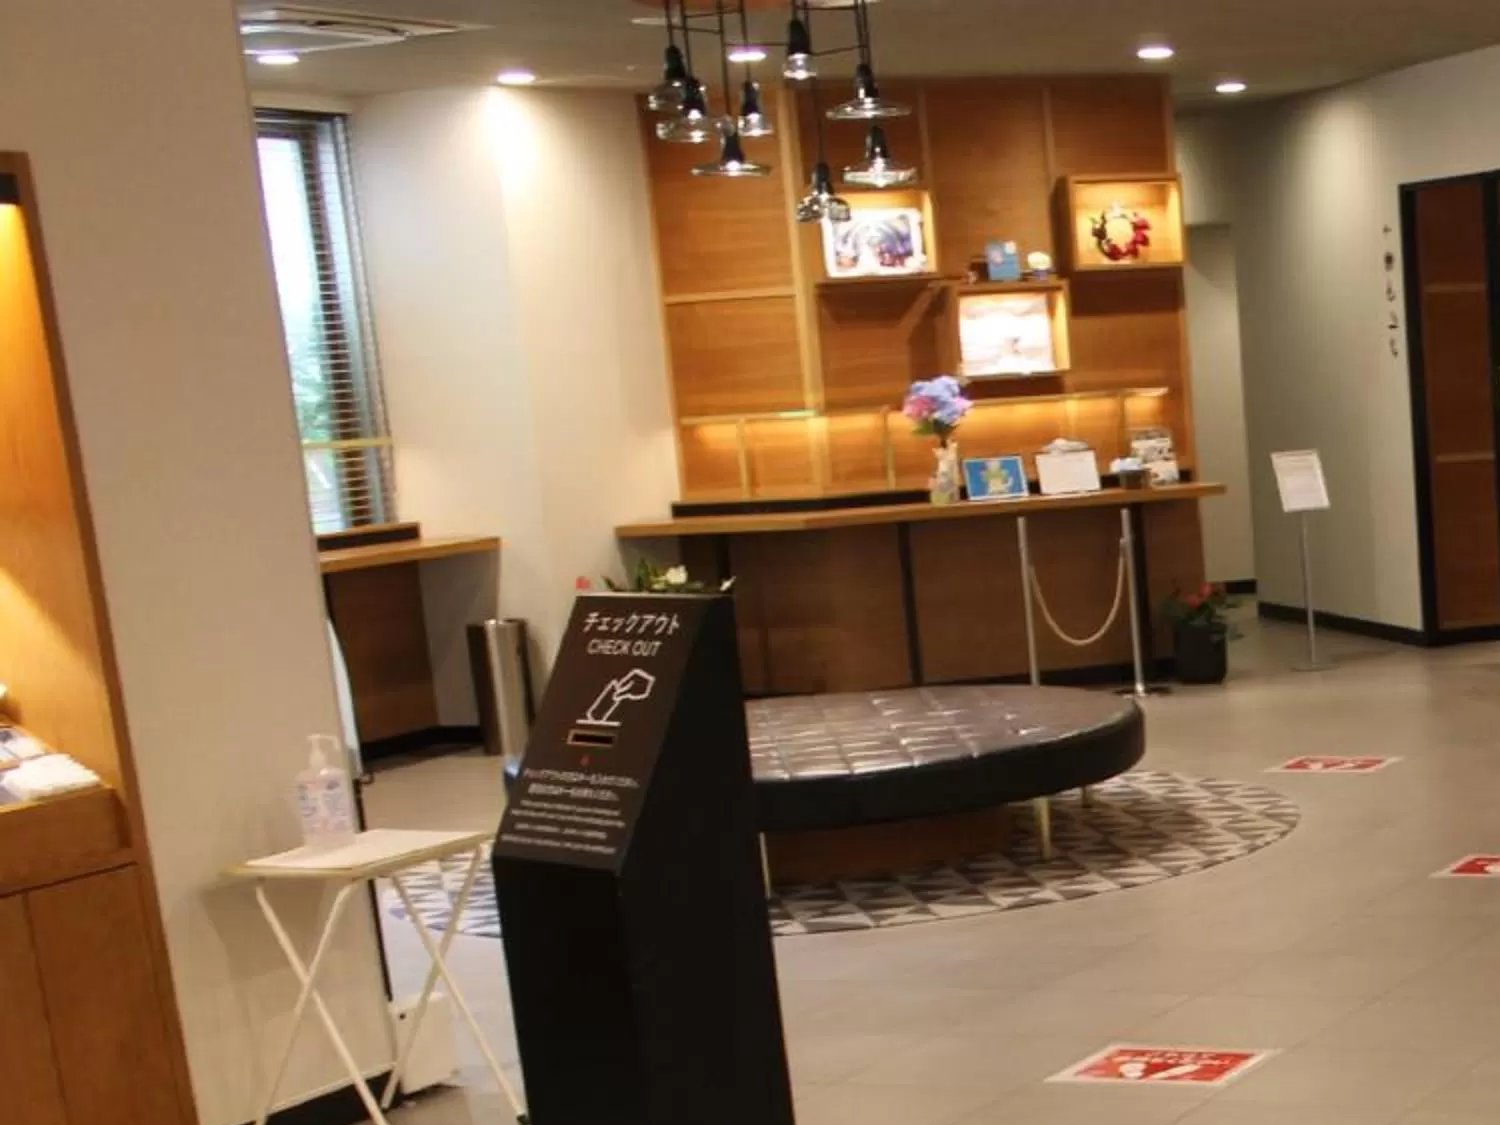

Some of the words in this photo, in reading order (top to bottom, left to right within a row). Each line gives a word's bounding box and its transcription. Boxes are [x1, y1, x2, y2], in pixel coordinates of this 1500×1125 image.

[583, 611, 680, 635] チェックアウト
[587, 639, 631, 655] CHECK
[632, 641, 662, 656] OUT
